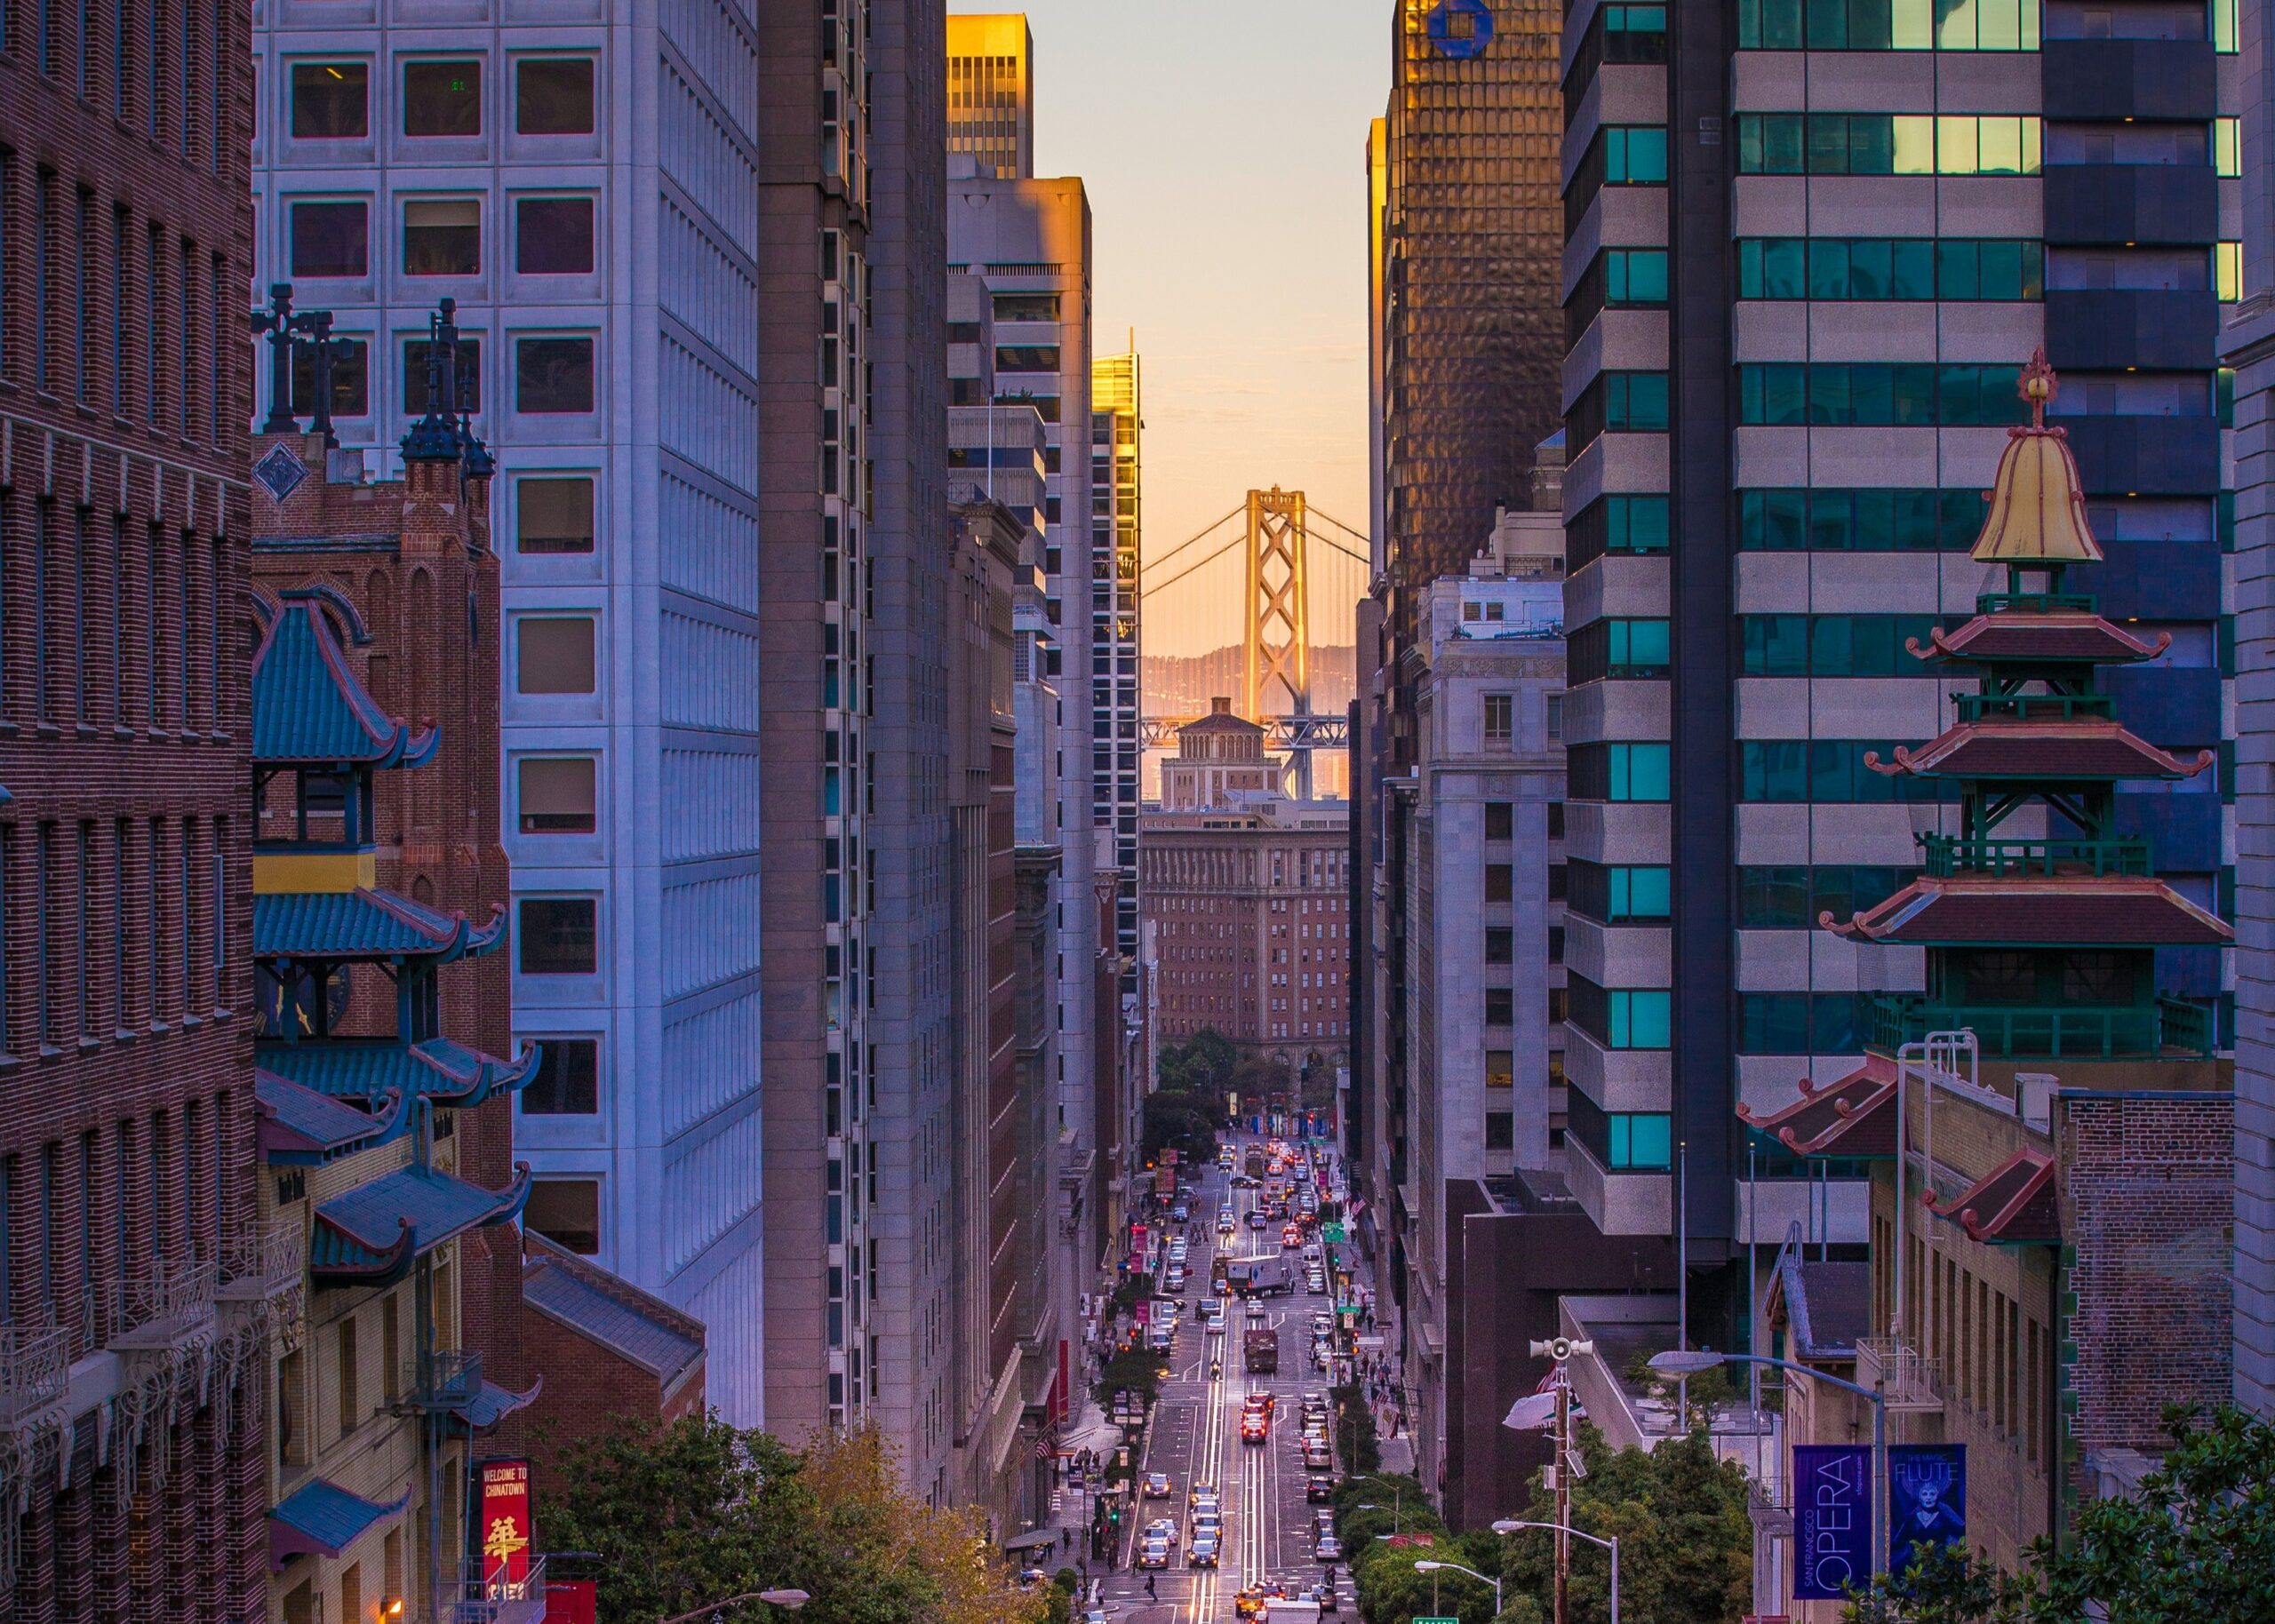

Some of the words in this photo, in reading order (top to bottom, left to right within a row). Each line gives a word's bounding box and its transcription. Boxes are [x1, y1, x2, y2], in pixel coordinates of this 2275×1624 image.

[483, 1468, 515, 1483] WELCOME
[517, 1467, 527, 1480] TO
[1895, 1463, 1959, 1482] FLUTE
[485, 1482, 525, 1497] CHINATOWN
[1816, 1455, 1851, 1590] OPERA
[1805, 1509, 1814, 1565] FRANCISCO
[1805, 1567, 1814, 1587] SAN
